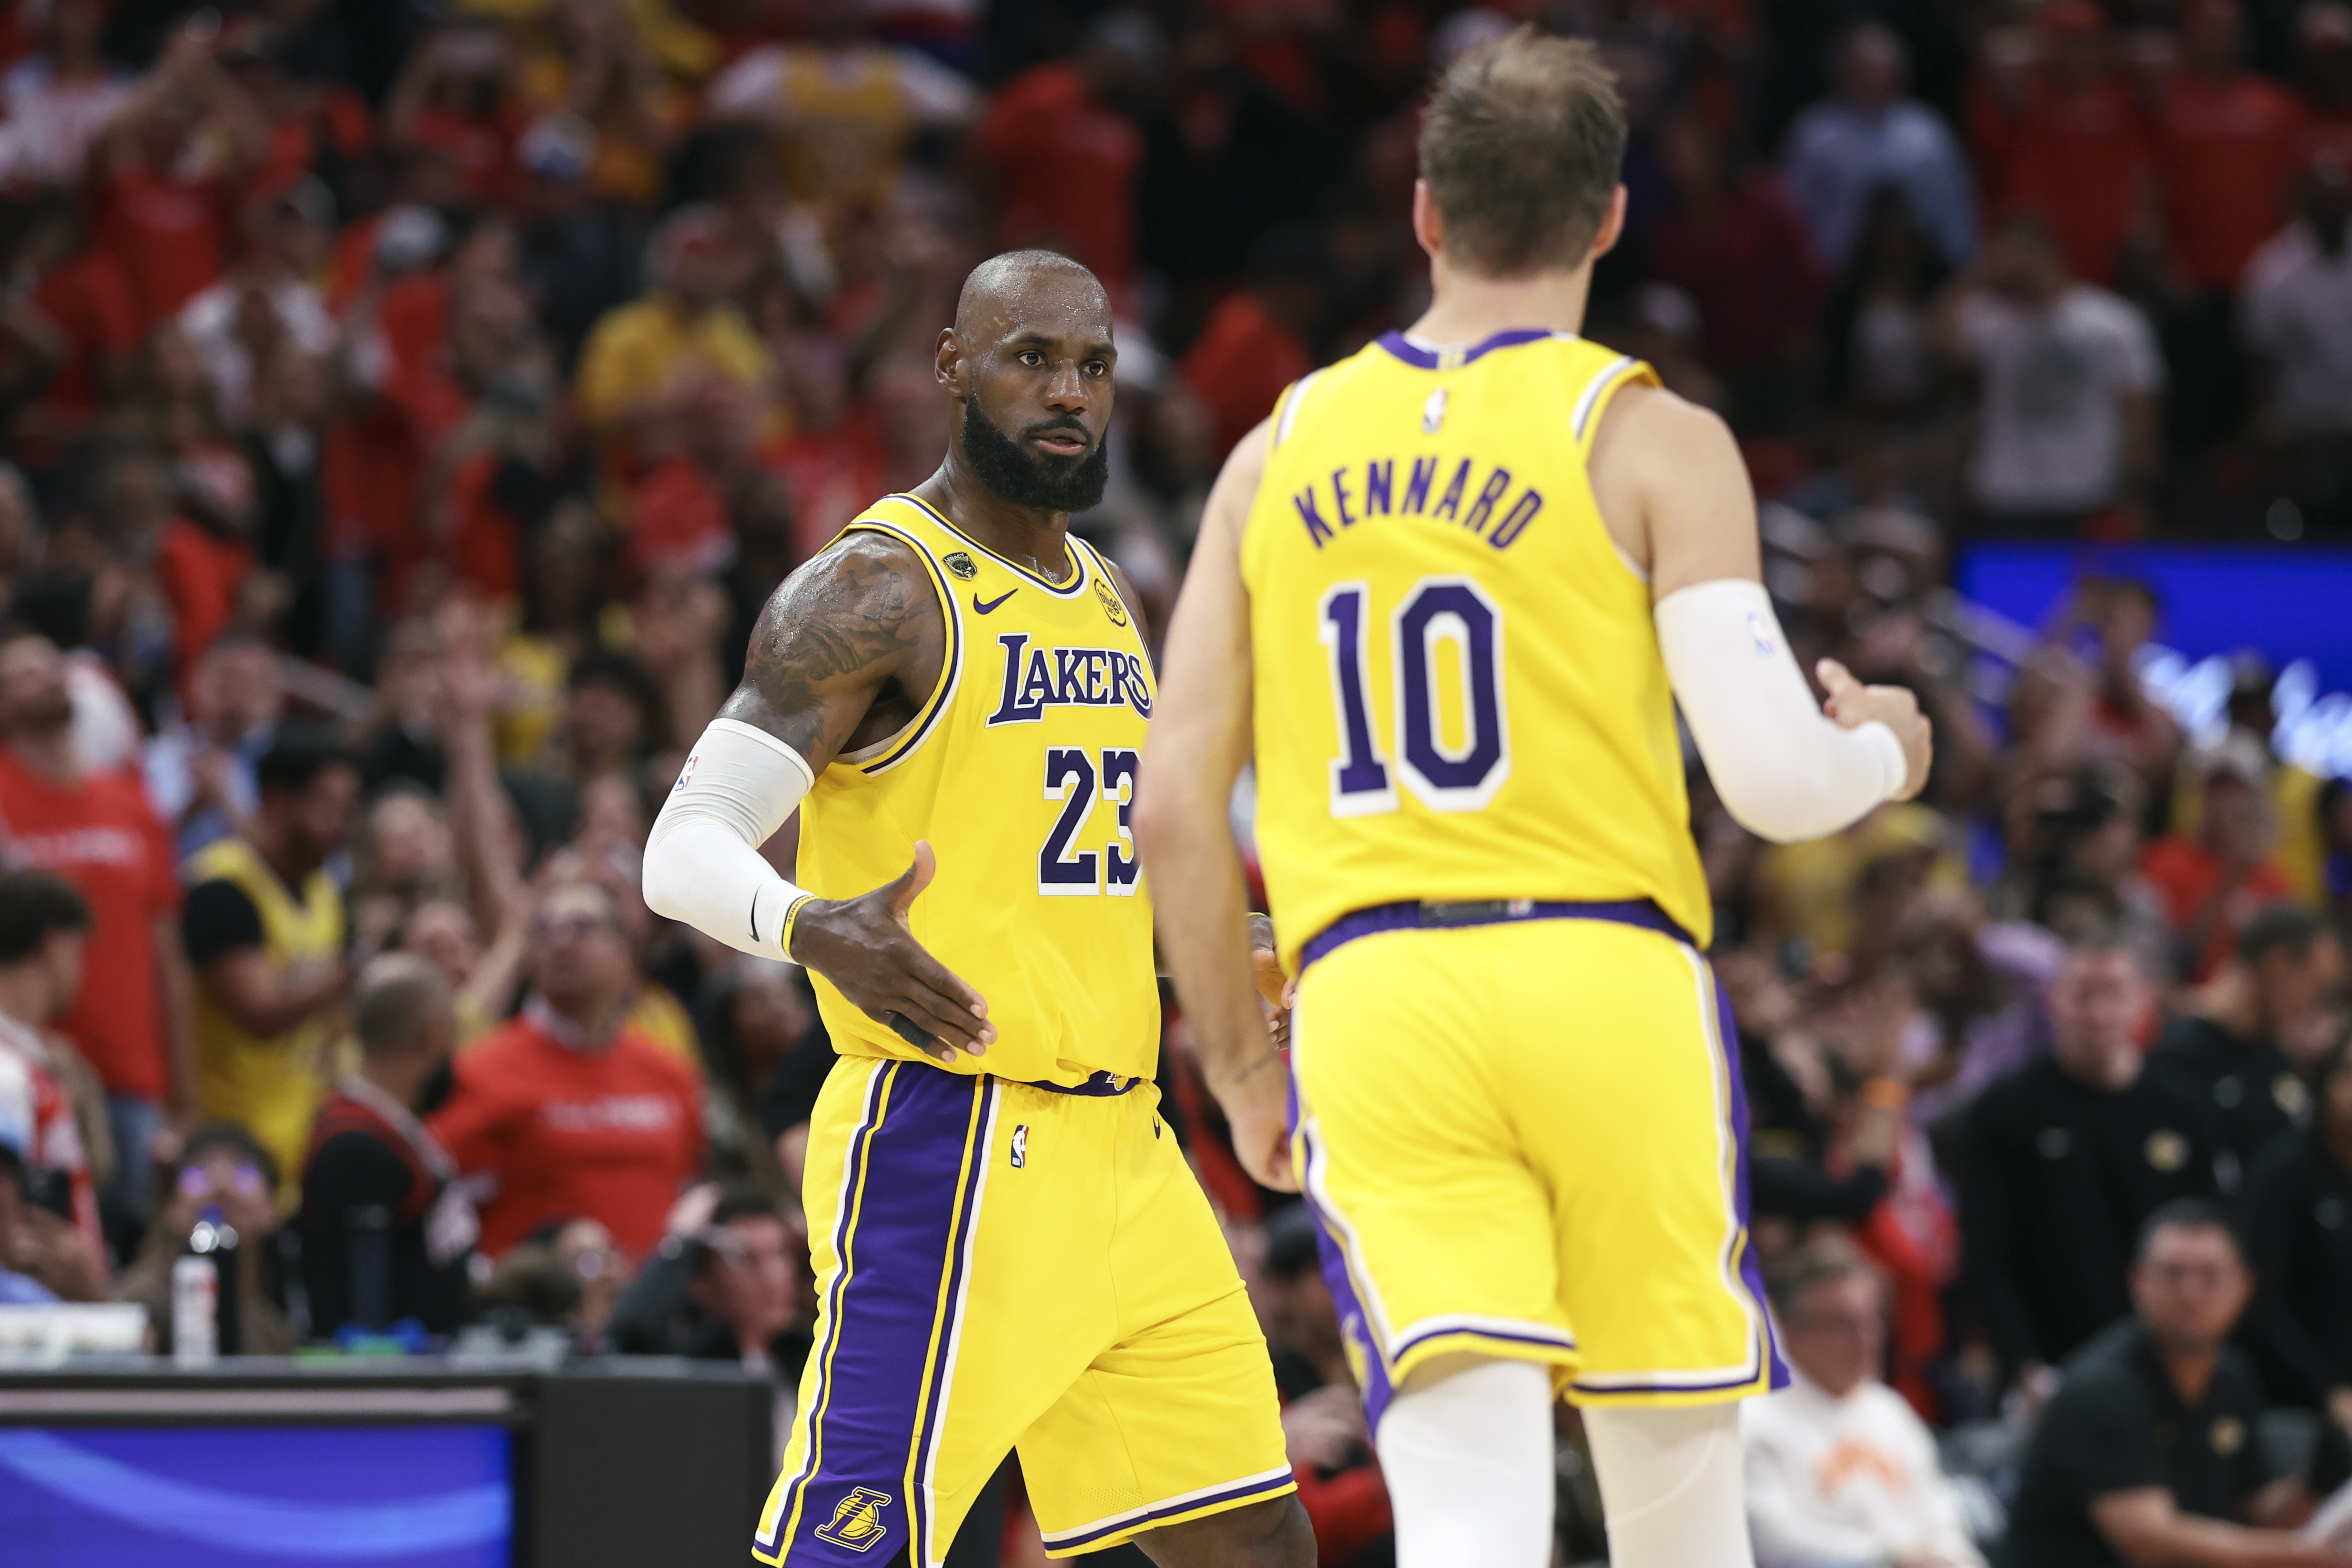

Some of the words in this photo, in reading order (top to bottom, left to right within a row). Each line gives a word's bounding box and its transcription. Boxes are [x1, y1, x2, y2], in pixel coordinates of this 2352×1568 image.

[1294, 457, 1542, 549] KENNARD
[944, 553, 964, 562] LEGACY
[985, 632, 1154, 728] LAKERS
[1317, 575, 1511, 819] 10
[1037, 746, 1144, 897] 23
